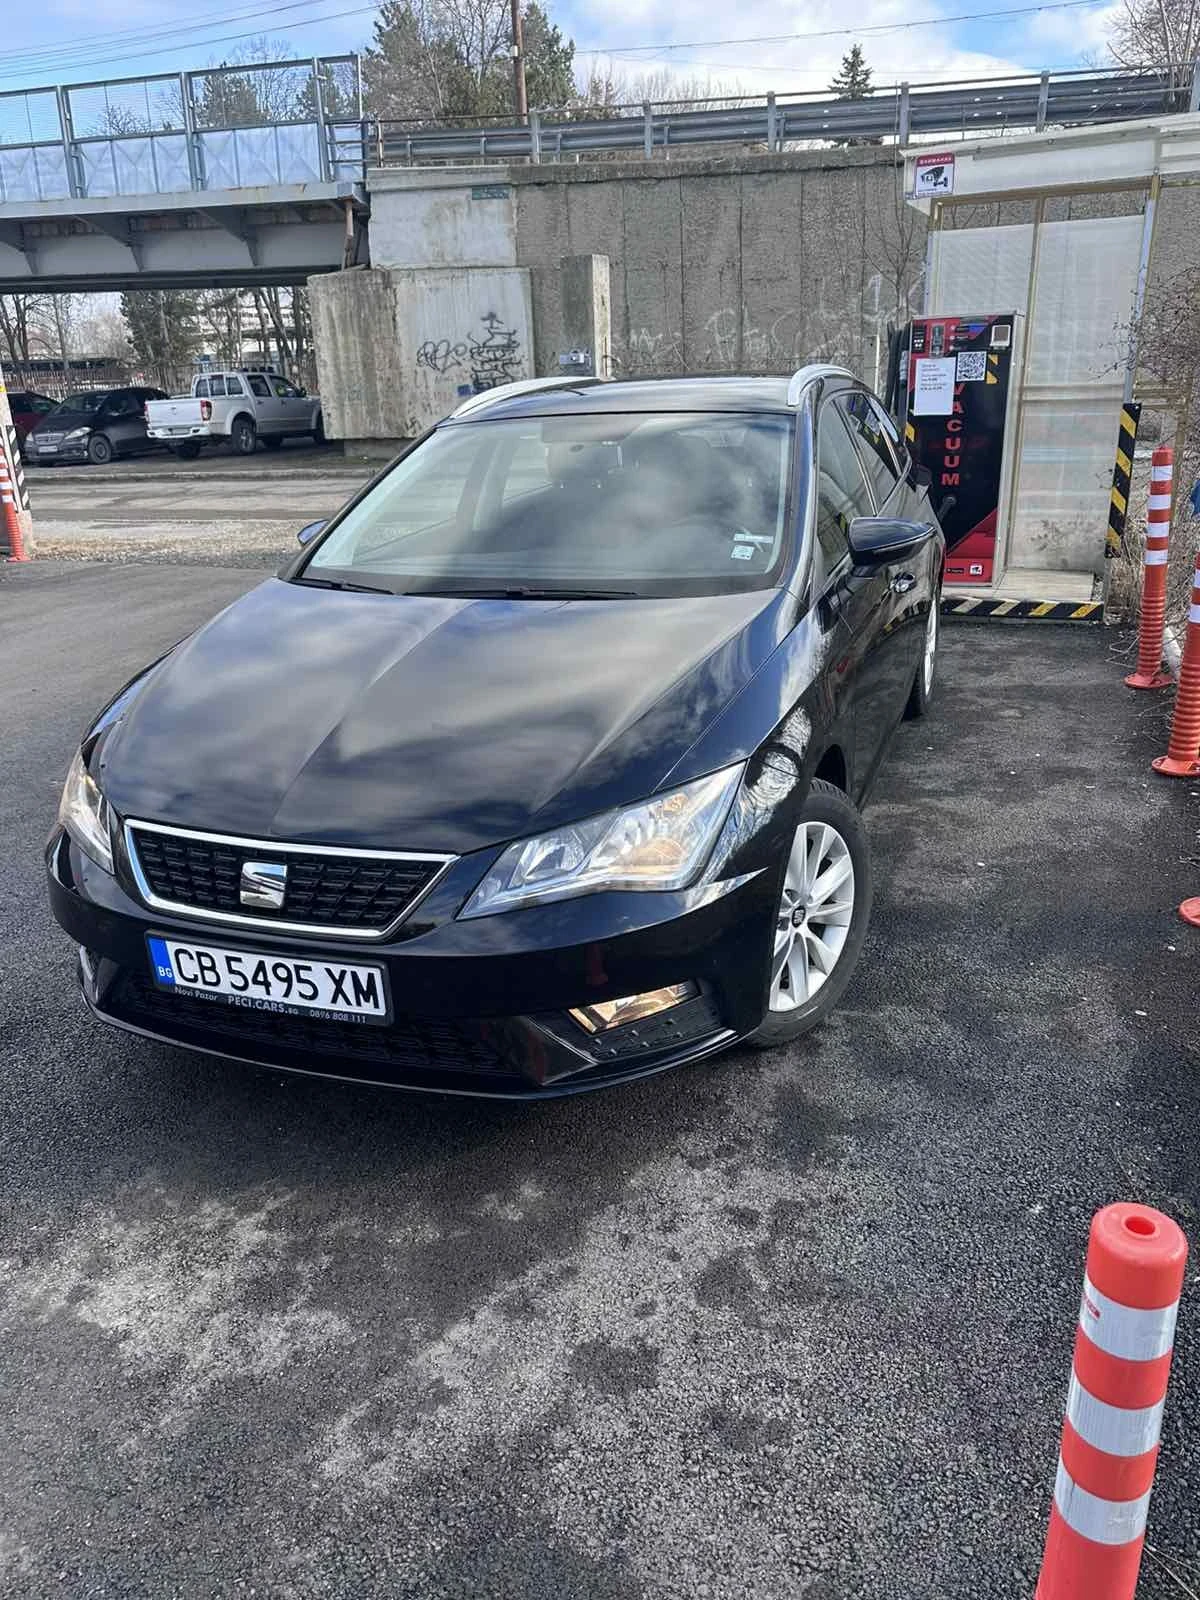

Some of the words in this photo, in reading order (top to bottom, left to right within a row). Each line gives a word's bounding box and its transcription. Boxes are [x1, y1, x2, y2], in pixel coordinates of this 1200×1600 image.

[941, 383, 965, 486] VACUUM
[157, 966, 173, 978] BG
[173, 948, 221, 987] CB
[225, 955, 319, 1001] 5495
[325, 967, 380, 1010] XM
